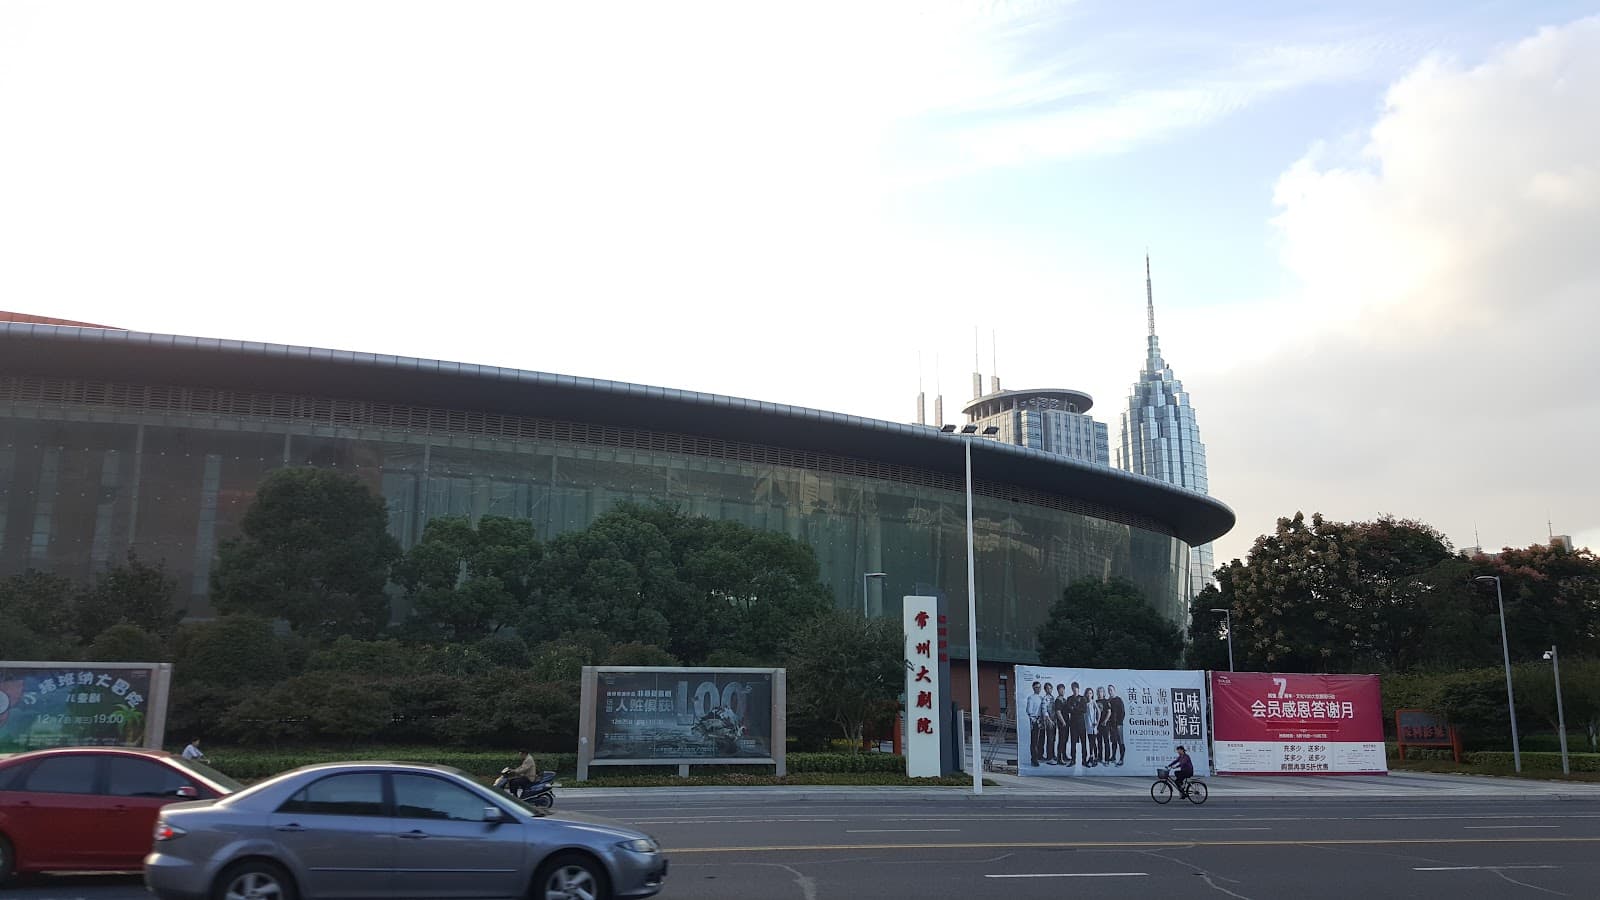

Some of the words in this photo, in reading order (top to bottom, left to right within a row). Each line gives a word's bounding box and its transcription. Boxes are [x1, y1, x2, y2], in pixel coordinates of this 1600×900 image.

[1173, 691, 1200, 714] 品味
[1251, 699, 1354, 720] 会员感恩答谢月
[1128, 717, 1169, 728] Geniehigh
[1174, 713, 1201, 736] 源音
